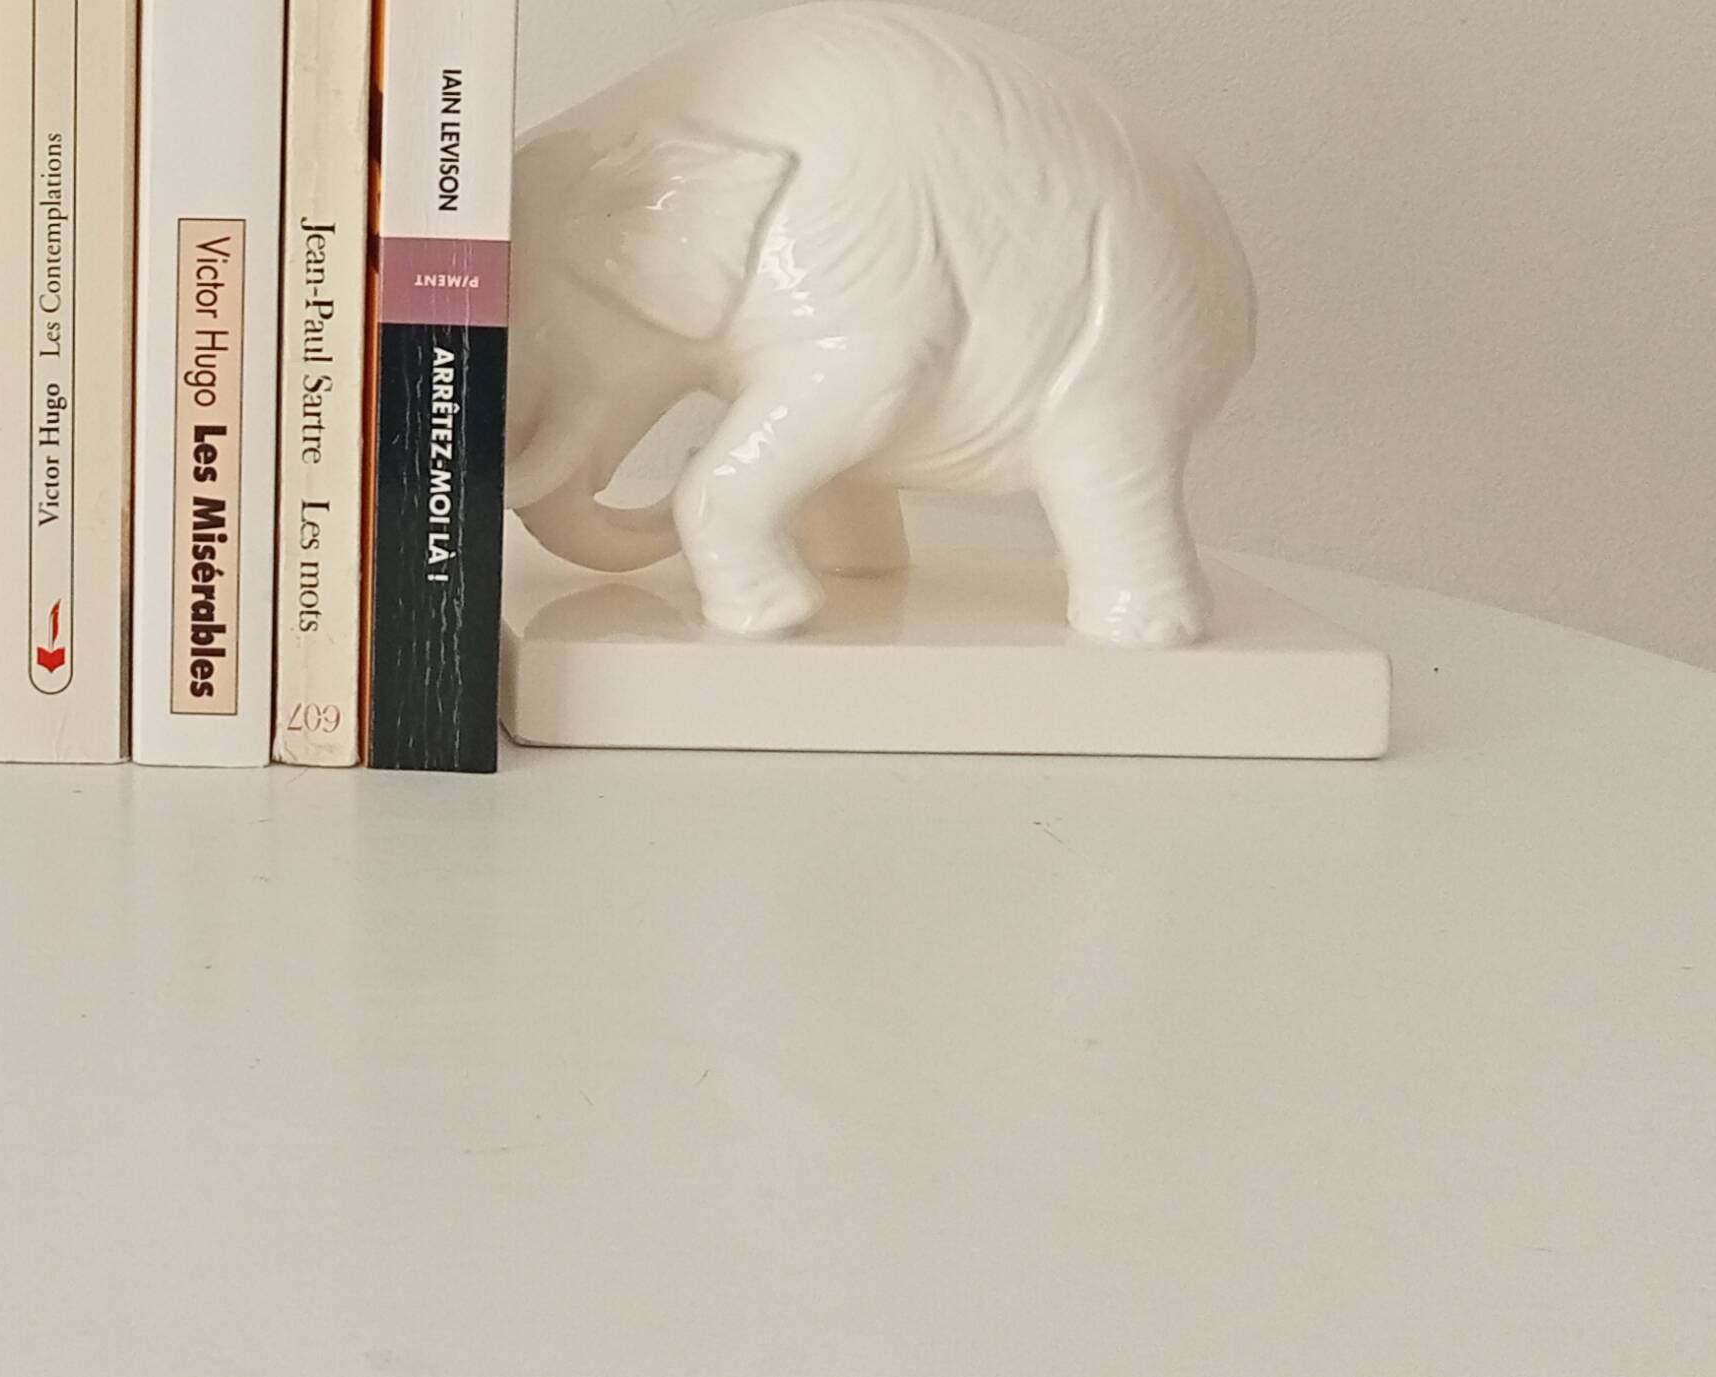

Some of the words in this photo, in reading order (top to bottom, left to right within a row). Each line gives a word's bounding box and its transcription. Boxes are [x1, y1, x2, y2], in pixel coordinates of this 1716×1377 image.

[440, 70, 462, 114] IAIN
[438, 122, 461, 211] LEVISON
[38, 133, 67, 313] Contemplations
[194, 236, 231, 318] Victor
[301, 217, 335, 362] Jean-Paul
[39, 322, 62, 358] Les
[184, 330, 229, 407] Hugo
[38, 383, 66, 447] Hugo
[300, 374, 332, 464] Sartre
[427, 347, 461, 523] ARRÊTEZ-MOI
[194, 425, 226, 482] Les
[38, 455, 62, 527] Victor
[299, 499, 330, 549] Les
[428, 532, 458, 565] LÀ
[189, 497, 226, 697] Misérables
[298, 562, 320, 632] mots
[288, 703, 341, 733] 607
